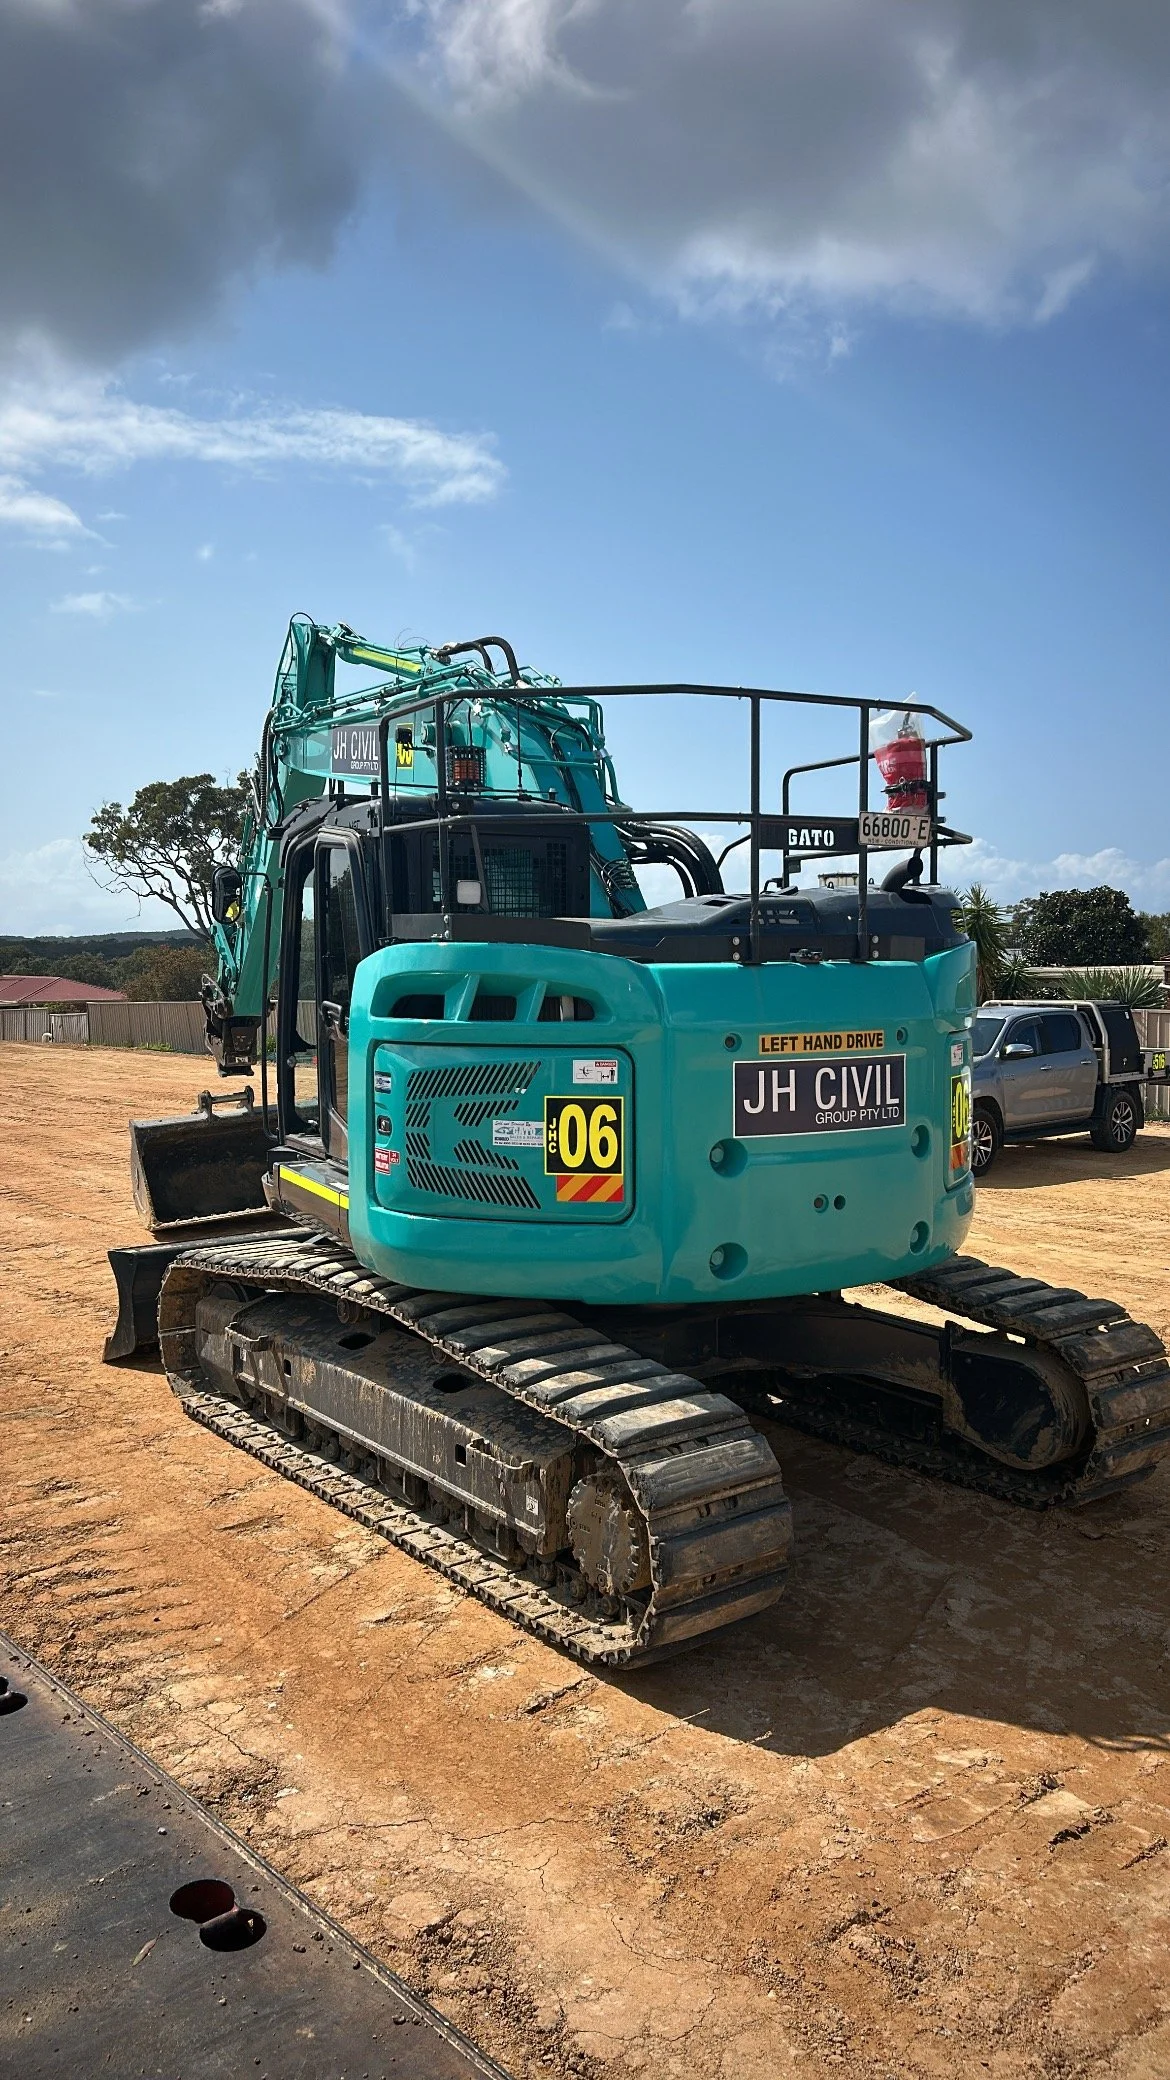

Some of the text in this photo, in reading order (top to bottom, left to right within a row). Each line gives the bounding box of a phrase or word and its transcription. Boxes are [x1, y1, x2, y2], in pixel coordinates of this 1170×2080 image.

[333, 731, 347, 760] JH
[351, 731, 379, 760] CIVIL
[788, 828, 835, 847] GATO
[761, 1032, 883, 1053] LEFT HAND DRIVE
[743, 1064, 900, 1114] JH CIVIL
[815, 1106, 900, 1125] GROUP PTY LTD
[548, 1117, 557, 1154] JHC
[558, 1103, 619, 1169] 06
